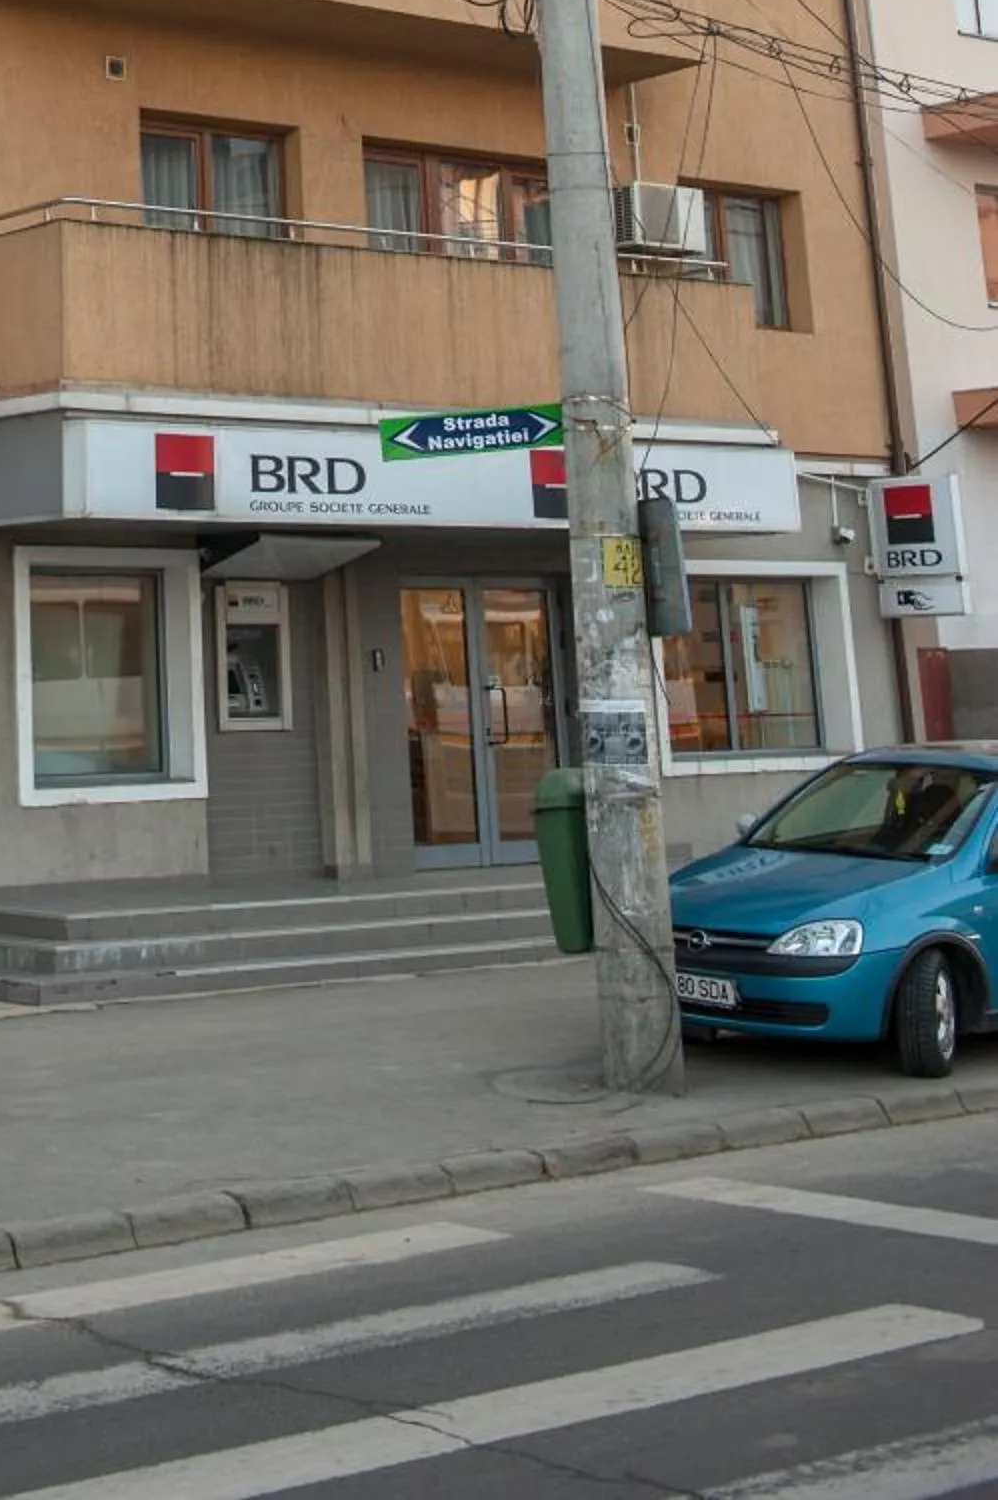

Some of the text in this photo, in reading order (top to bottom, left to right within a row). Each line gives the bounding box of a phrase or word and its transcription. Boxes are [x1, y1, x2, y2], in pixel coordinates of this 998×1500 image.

[443, 413, 510, 431] Strada
[250, 454, 366, 495] BRD
[634, 468, 707, 503] RD
[249, 500, 304, 513] GROUPE
[886, 549, 943, 569] BRD
